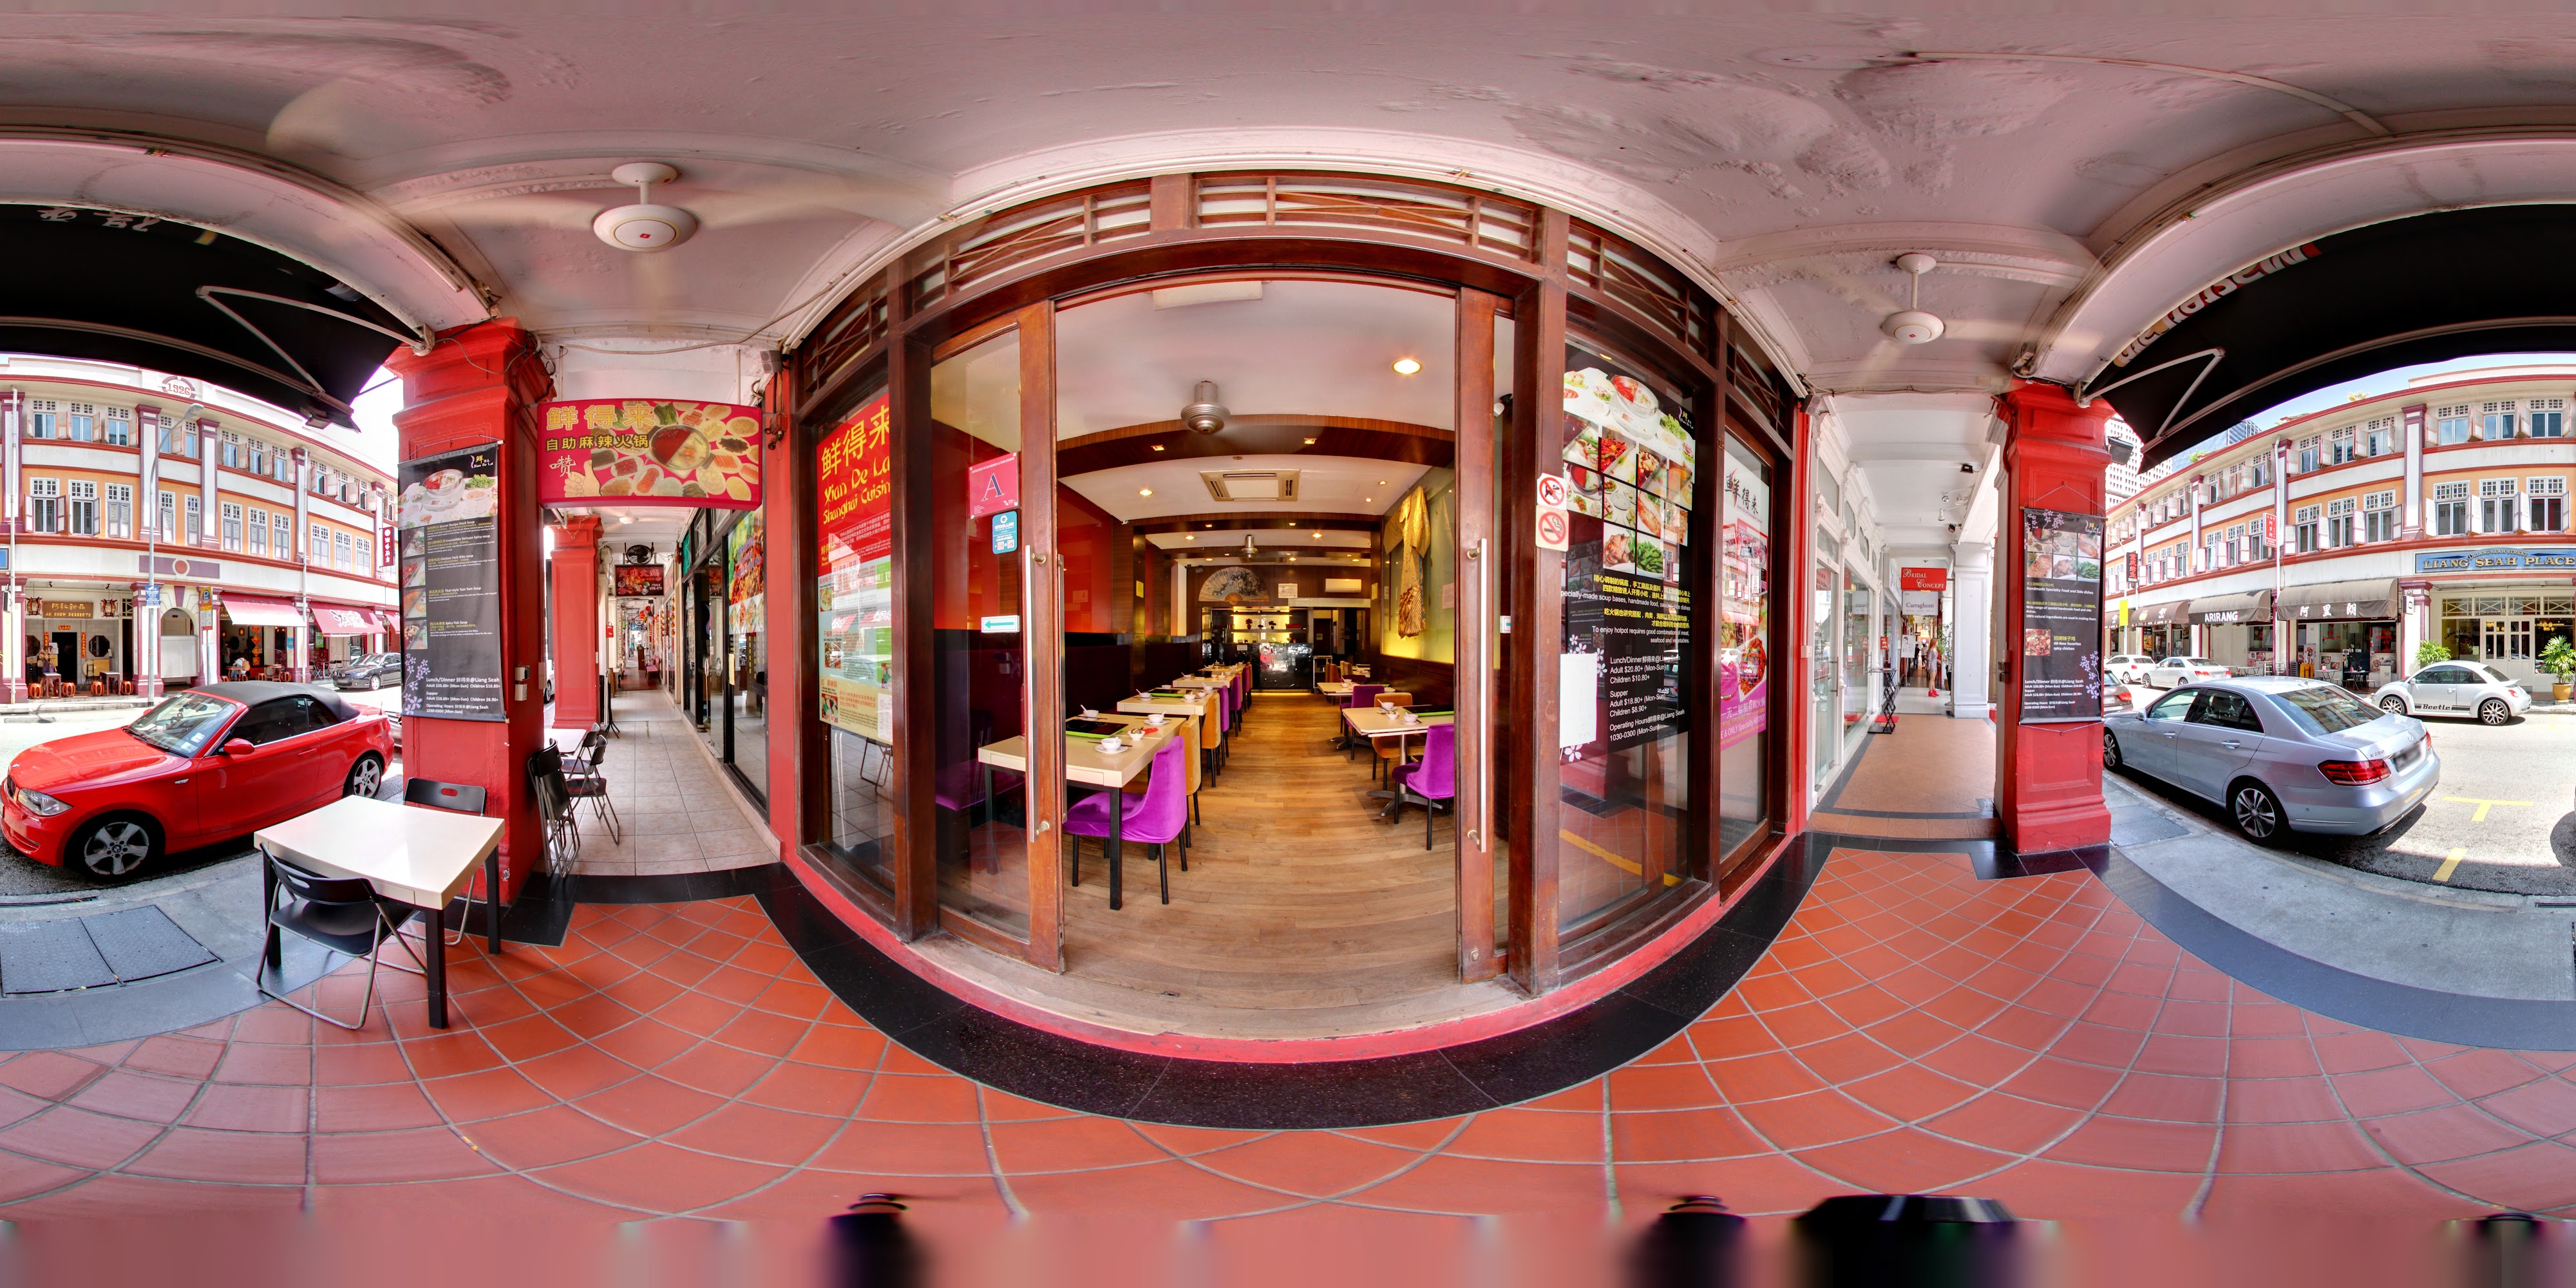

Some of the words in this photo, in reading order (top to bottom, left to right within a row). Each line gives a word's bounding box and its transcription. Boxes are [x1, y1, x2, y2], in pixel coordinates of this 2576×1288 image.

[546, 404, 655, 431] 鲜得来
[546, 434, 649, 452] 自助麻辣火锅
[822, 404, 889, 481] 鲜得来
[824, 482, 848, 507] Xian
[851, 468, 868, 489] De
[981, 473, 1005, 502] A
[1725, 473, 1759, 515] 鲜得来
[823, 493, 857, 525] Shanghai
[861, 480, 890, 504] Cuisin
[2472, 550, 2490, 559] LIANG
[2423, 559, 2470, 569] LIANG
[2476, 558, 2518, 567] SEAH
[2524, 556, 2575, 565] PLACE
[1903, 569, 1927, 578] BRIDAL
[1917, 578, 1944, 588] CONCEPT
[204, 591, 209, 600] P
[1561, 590, 1598, 600] pecially-made
[1613, 595, 1627, 603] bases,
[1628, 597, 1649, 606] handmade
[1650, 599, 1659, 607] food,
[2205, 611, 2238, 622] ARIRANG
[2300, 603, 2357, 617] 阿里朗
[1644, 664, 1667, 672] (Mon-Sun)
[1632, 674, 1650, 683] $10.80+
[1610, 690, 1628, 698] Supper
[1643, 694, 1666, 703] (Mon-Sun)
[1632, 705, 1647, 714] $8.90+
[1610, 721, 1634, 732] Operating
[1728, 725, 1738, 735] ONLY
[1754, 714, 1765, 724] HOTPOT
[1610, 730, 1636, 741] 1030-0300
[1636, 724, 1660, 736] (Mon-Sun)
